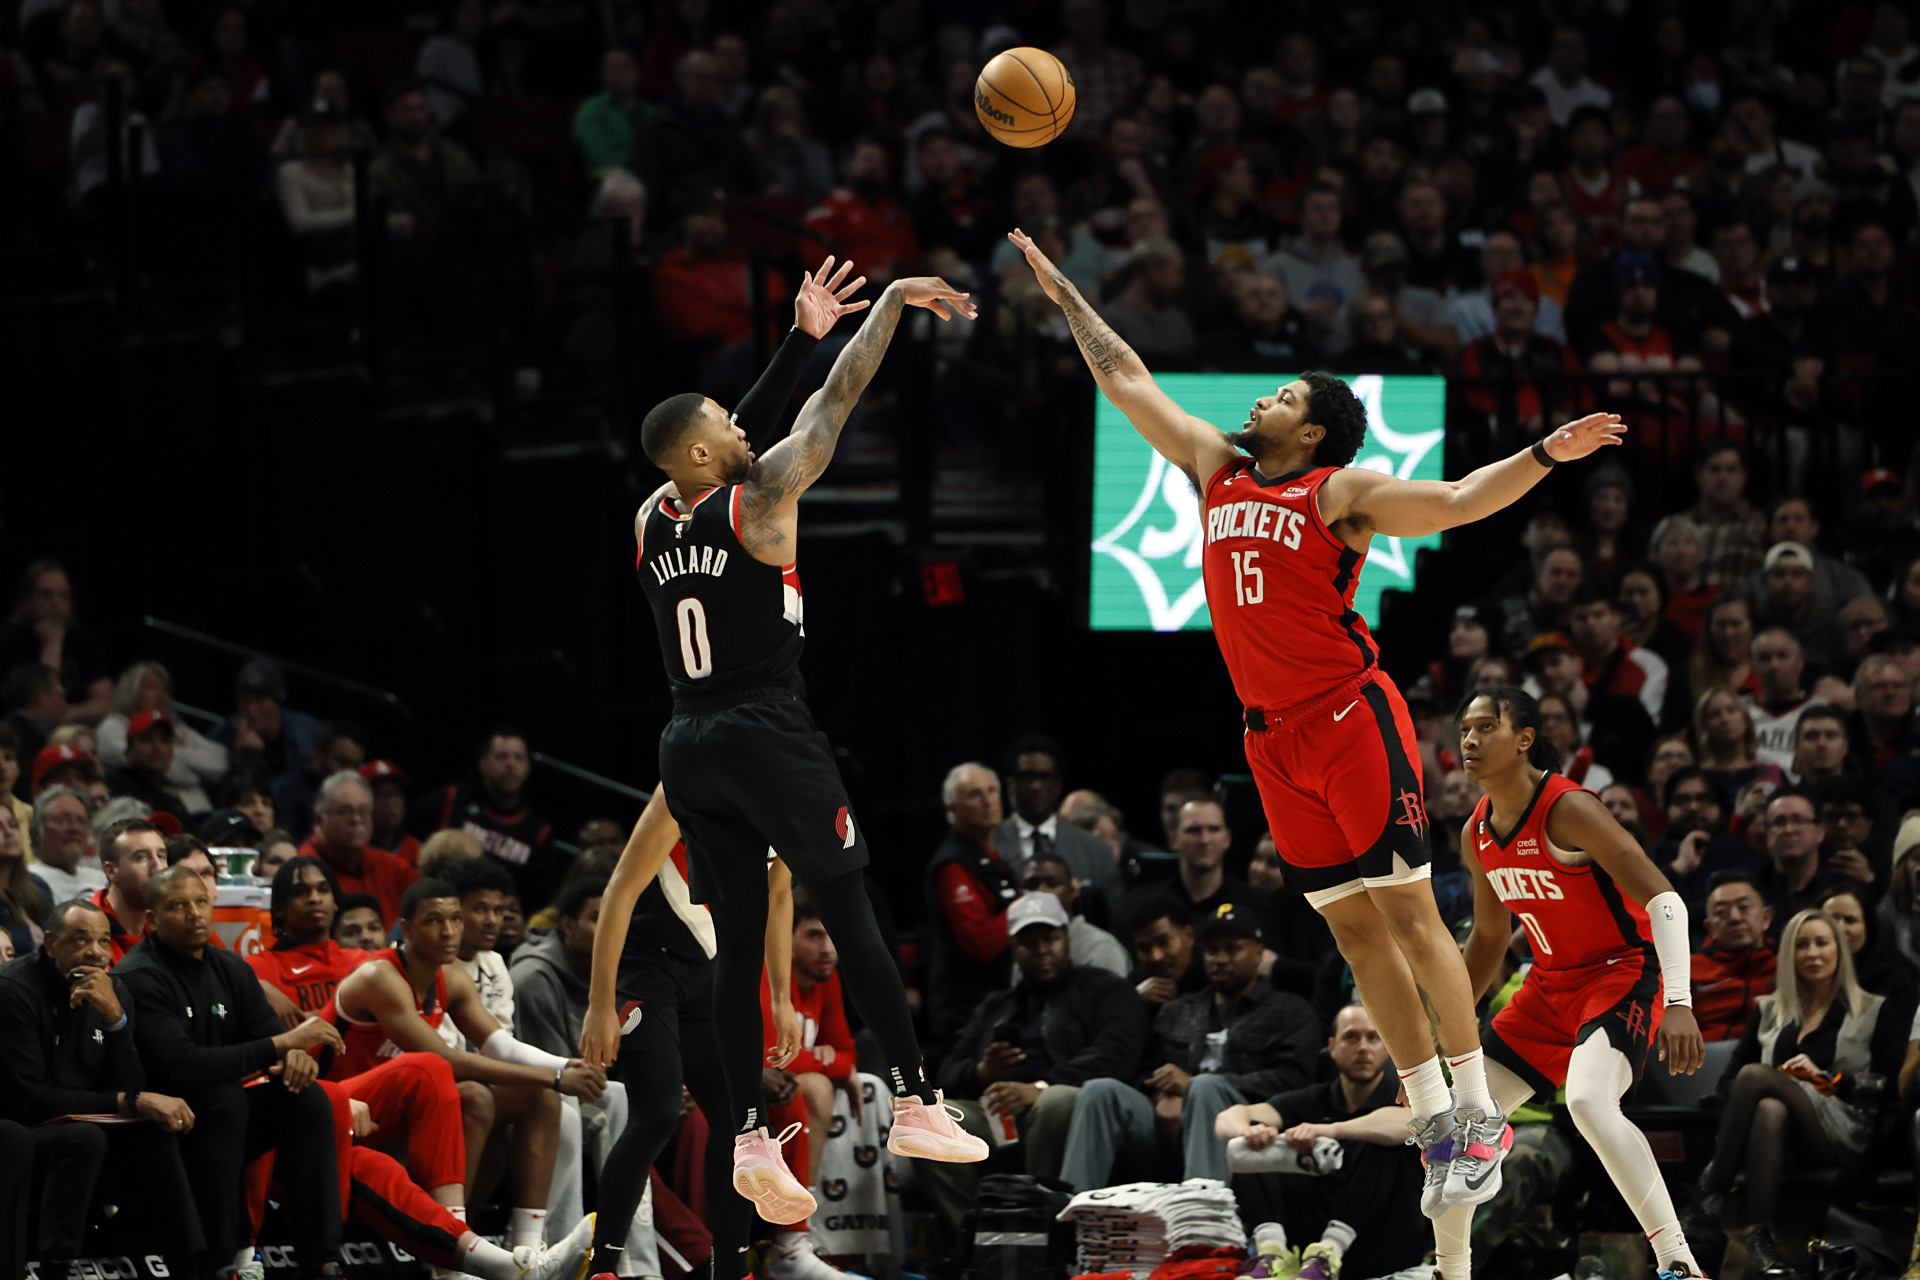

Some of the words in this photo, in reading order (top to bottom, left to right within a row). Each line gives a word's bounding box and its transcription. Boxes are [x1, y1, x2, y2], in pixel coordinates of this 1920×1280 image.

[1207, 500, 1306, 551] ROCKETS
[649, 545, 729, 587] LILLARD
[1230, 550, 1264, 607] 15
[676, 597, 714, 680] 0
[1516, 838, 1538, 848] credit
[1516, 847, 1540, 856] karma
[1485, 867, 1565, 903] OCKETS
[1518, 912, 1553, 956] 0
